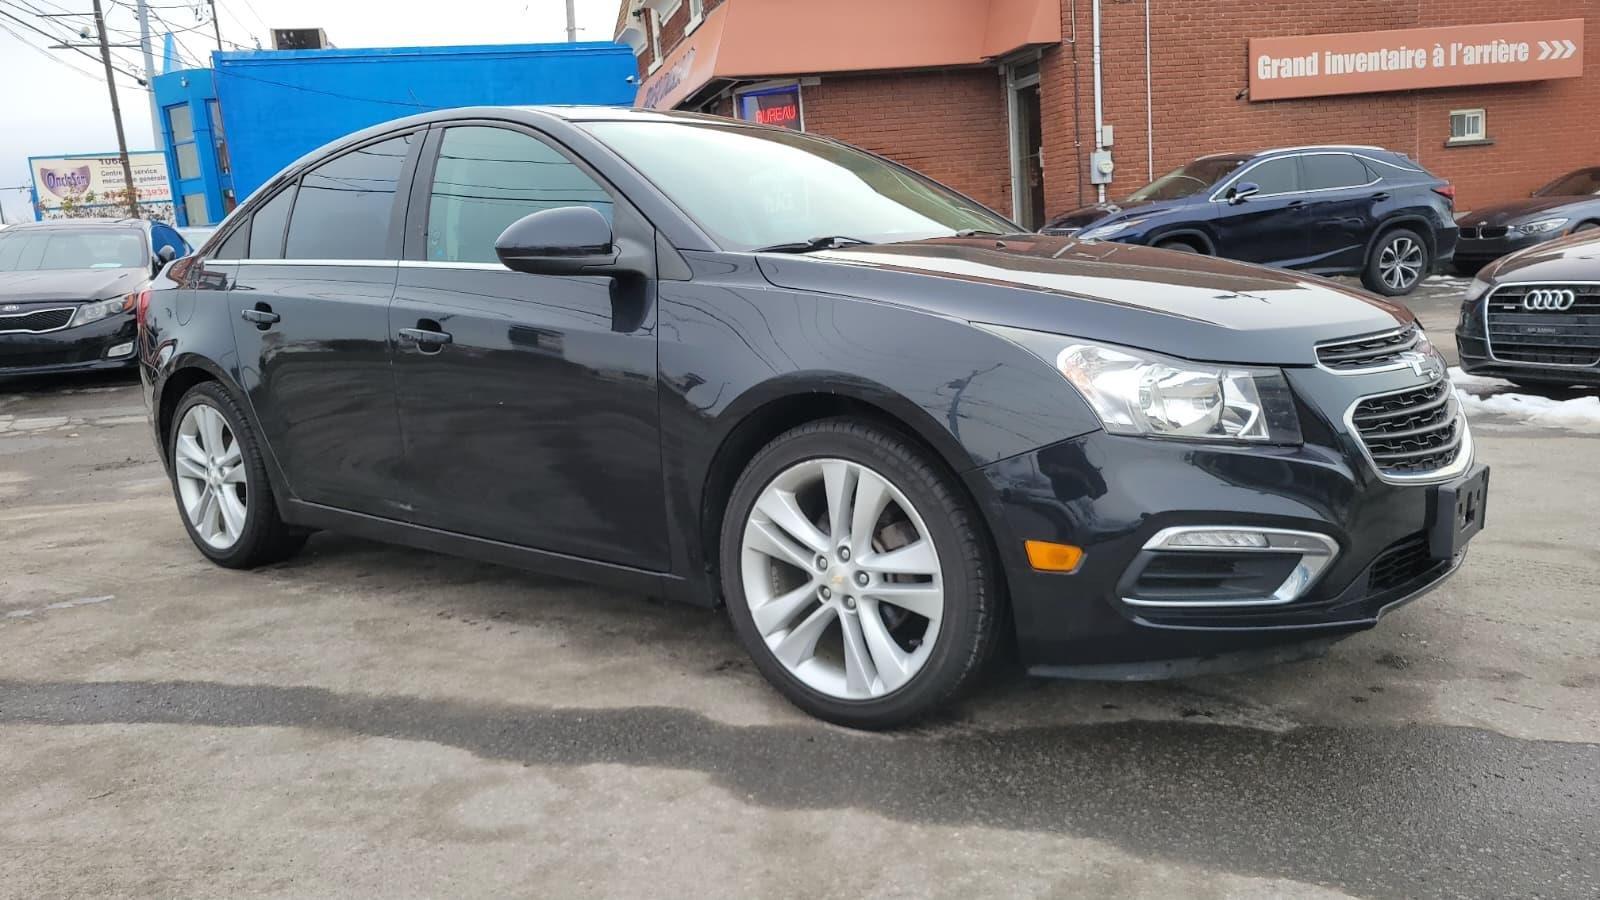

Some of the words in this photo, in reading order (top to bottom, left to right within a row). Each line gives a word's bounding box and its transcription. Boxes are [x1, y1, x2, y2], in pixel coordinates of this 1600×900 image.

[1257, 53, 1318, 80] Grand
[1325, 46, 1427, 75] inventaire
[1432, 43, 1444, 67] à
[1450, 39, 1529, 66] l'arrière
[755, 104, 796, 124] BUREAU
